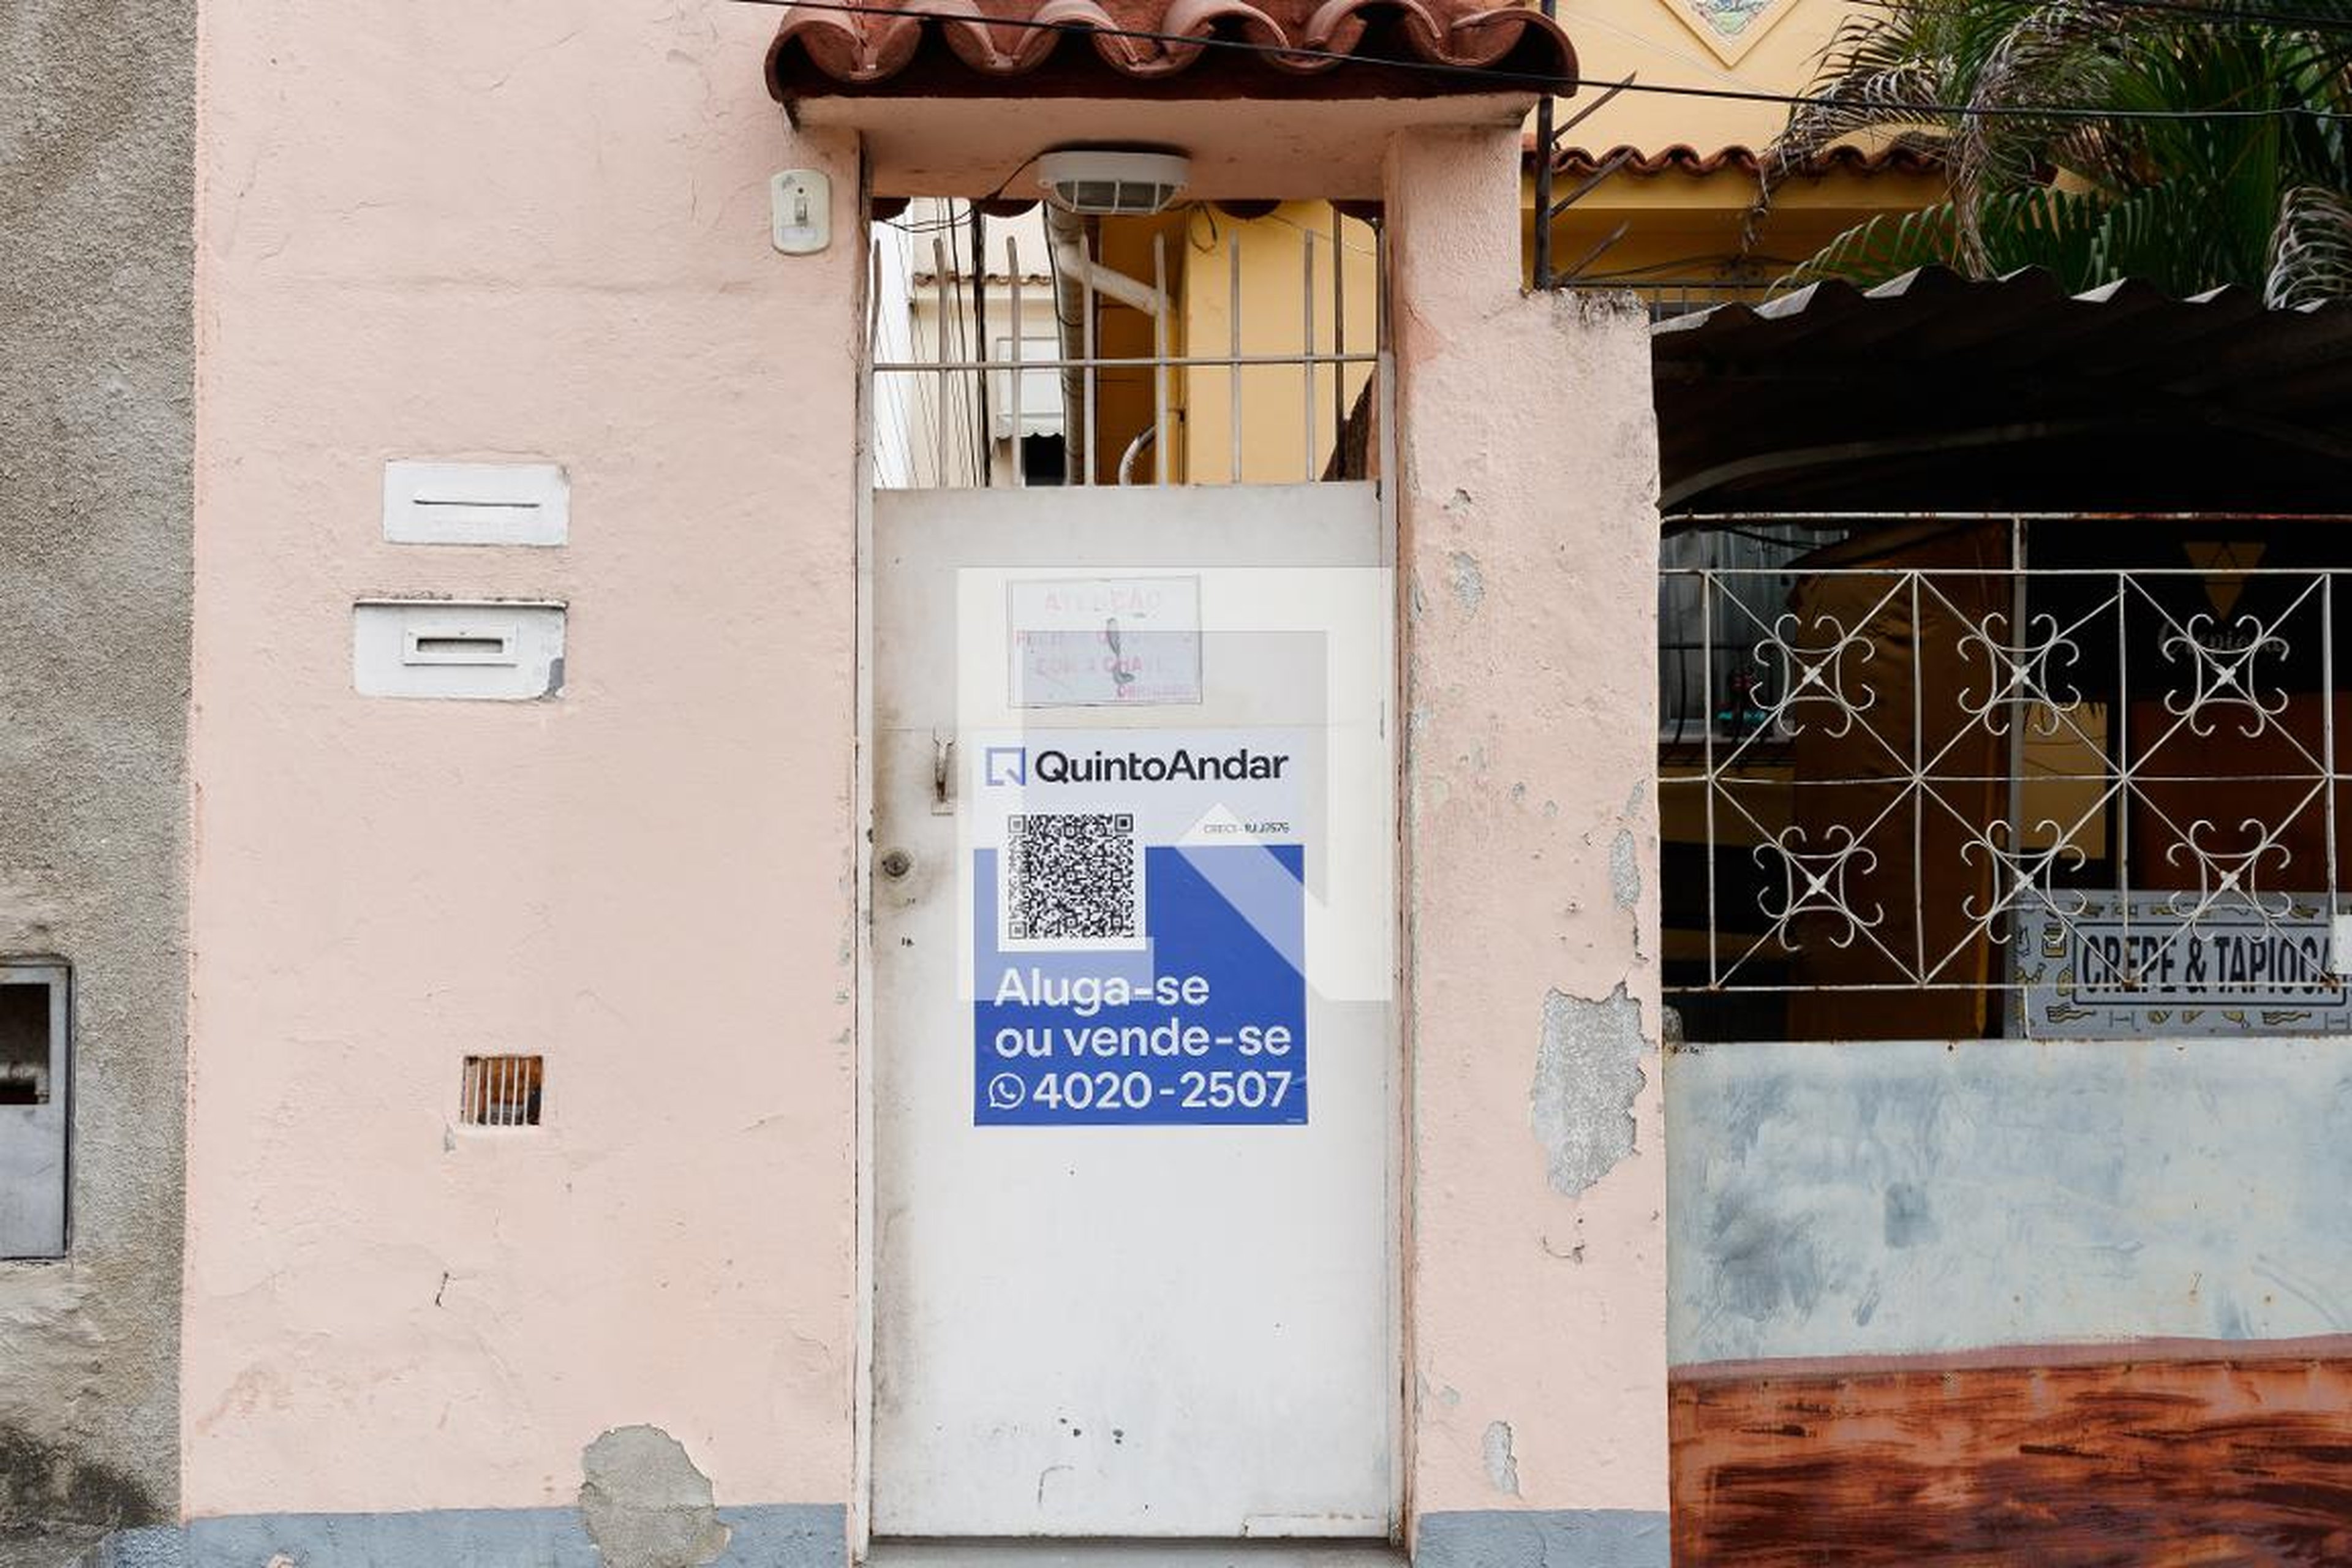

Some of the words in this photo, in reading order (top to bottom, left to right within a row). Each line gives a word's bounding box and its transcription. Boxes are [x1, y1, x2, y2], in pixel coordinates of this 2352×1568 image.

[1035, 749, 1289, 784] QuintoAndar
[2084, 935, 2177, 993] CREPE
[2185, 936, 2207, 993] &
[994, 968, 1210, 1017] Aluga-se
[995, 1027, 1052, 1058] ou
[1064, 1017, 1292, 1056] vende-se
[1033, 1071, 1292, 1109] 4020-2507
